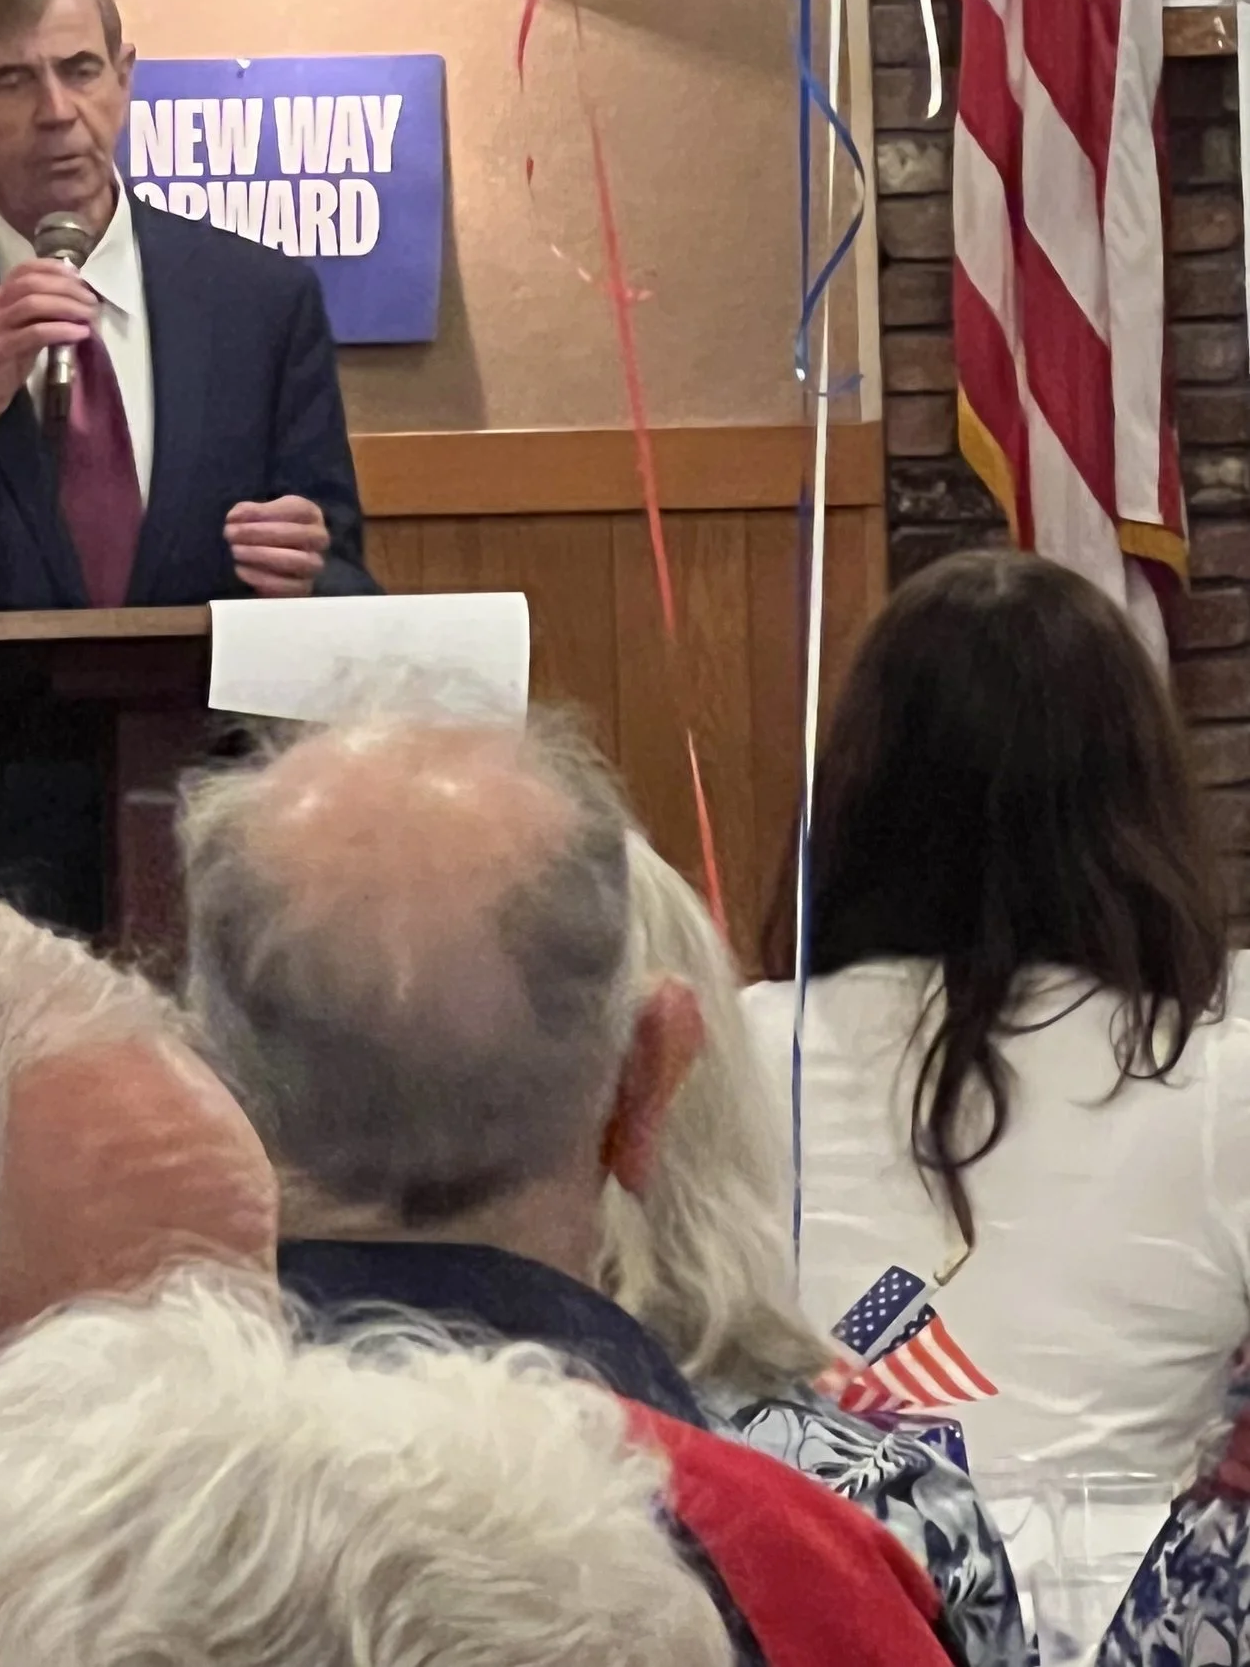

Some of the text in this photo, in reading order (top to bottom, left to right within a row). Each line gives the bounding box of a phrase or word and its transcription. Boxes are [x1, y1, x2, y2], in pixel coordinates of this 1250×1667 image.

[130, 95, 403, 177] NEW WAY
[133, 179, 380, 257] WARD
